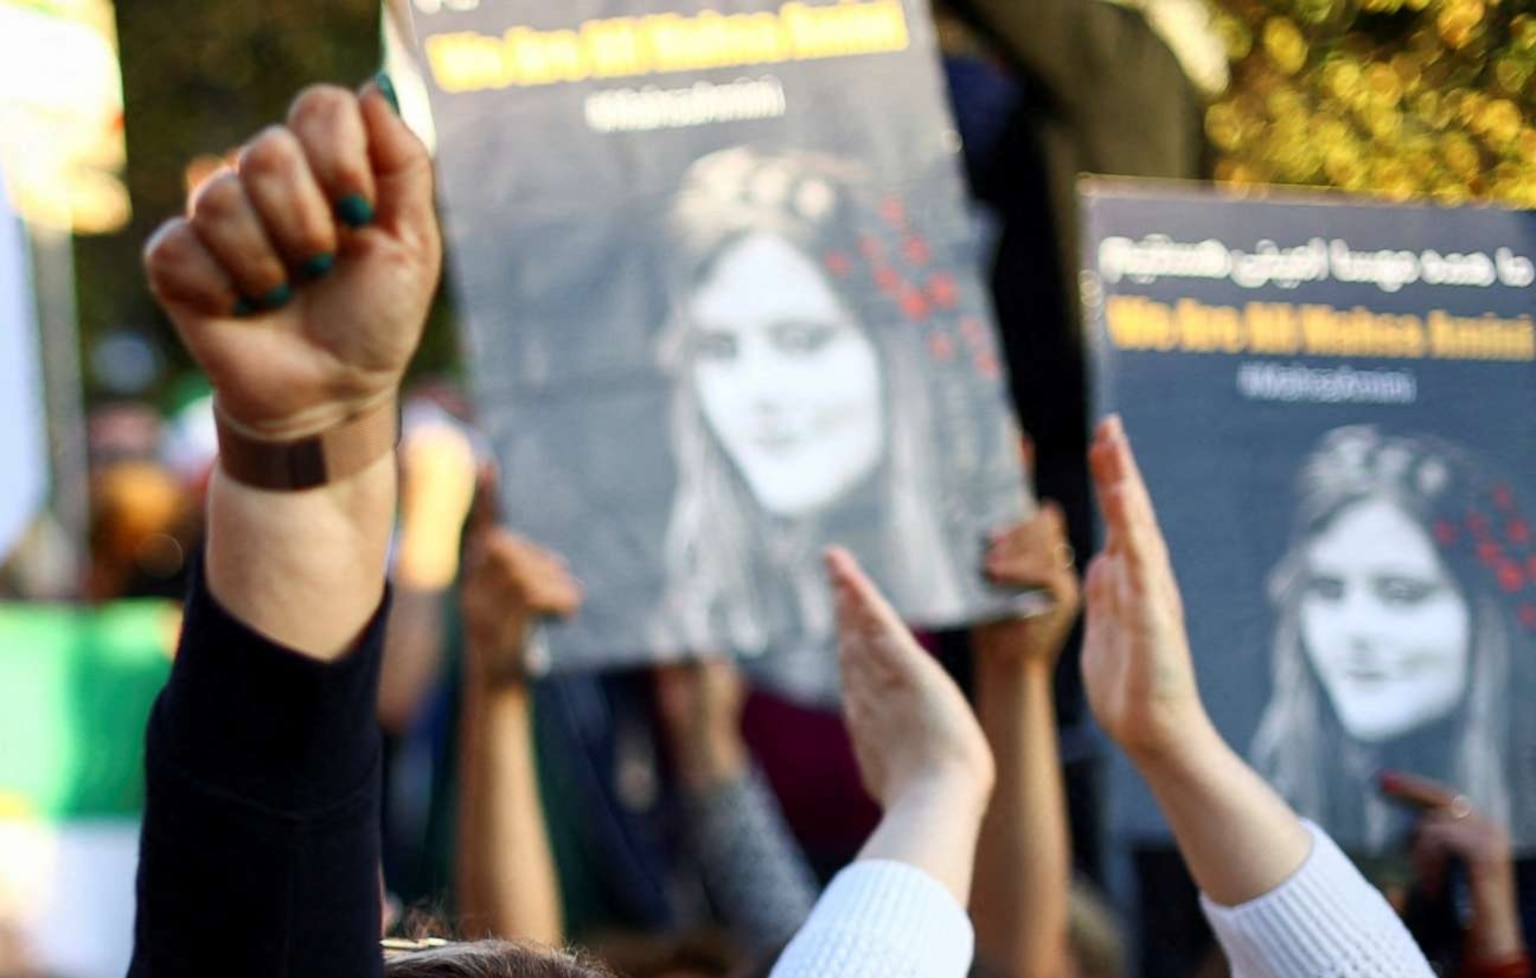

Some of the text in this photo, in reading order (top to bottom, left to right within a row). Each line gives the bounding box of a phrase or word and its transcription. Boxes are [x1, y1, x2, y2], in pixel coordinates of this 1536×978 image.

[505, 26, 583, 85] Are
[582, 17, 640, 77] All
[1105, 295, 1175, 351] We
[1175, 298, 1242, 353] Are
[1244, 302, 1299, 355] All
[1300, 305, 1425, 358] Mahsa
